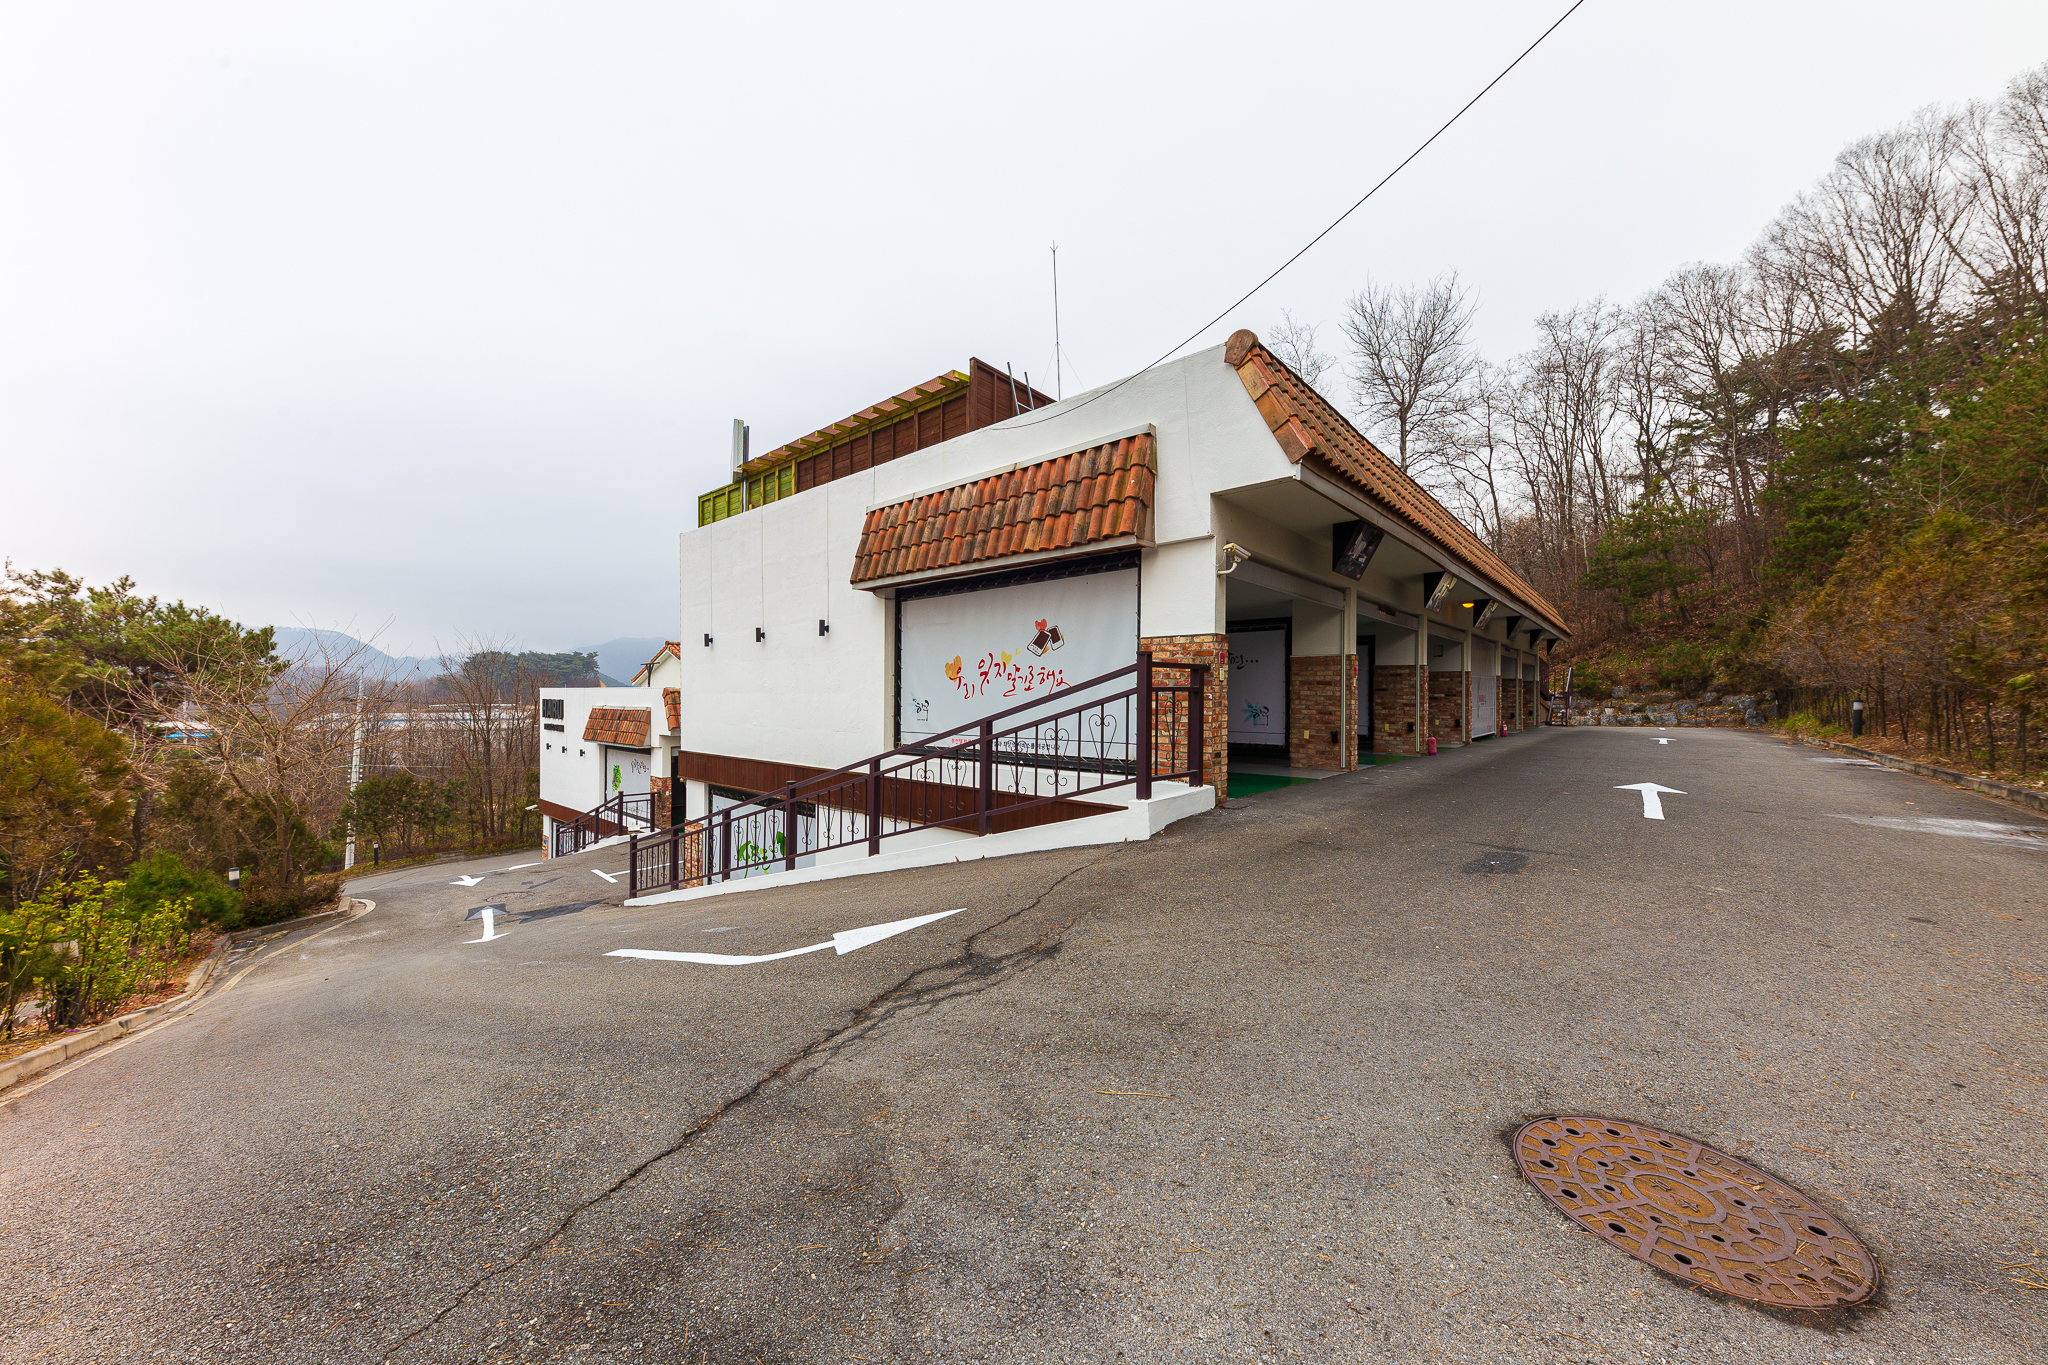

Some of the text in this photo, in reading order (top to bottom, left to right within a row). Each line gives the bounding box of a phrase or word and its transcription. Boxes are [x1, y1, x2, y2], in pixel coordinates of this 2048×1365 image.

[949, 656, 975, 699] 우리
[1037, 667, 1073, 695] 해요
[542, 699, 564, 720] HARU
